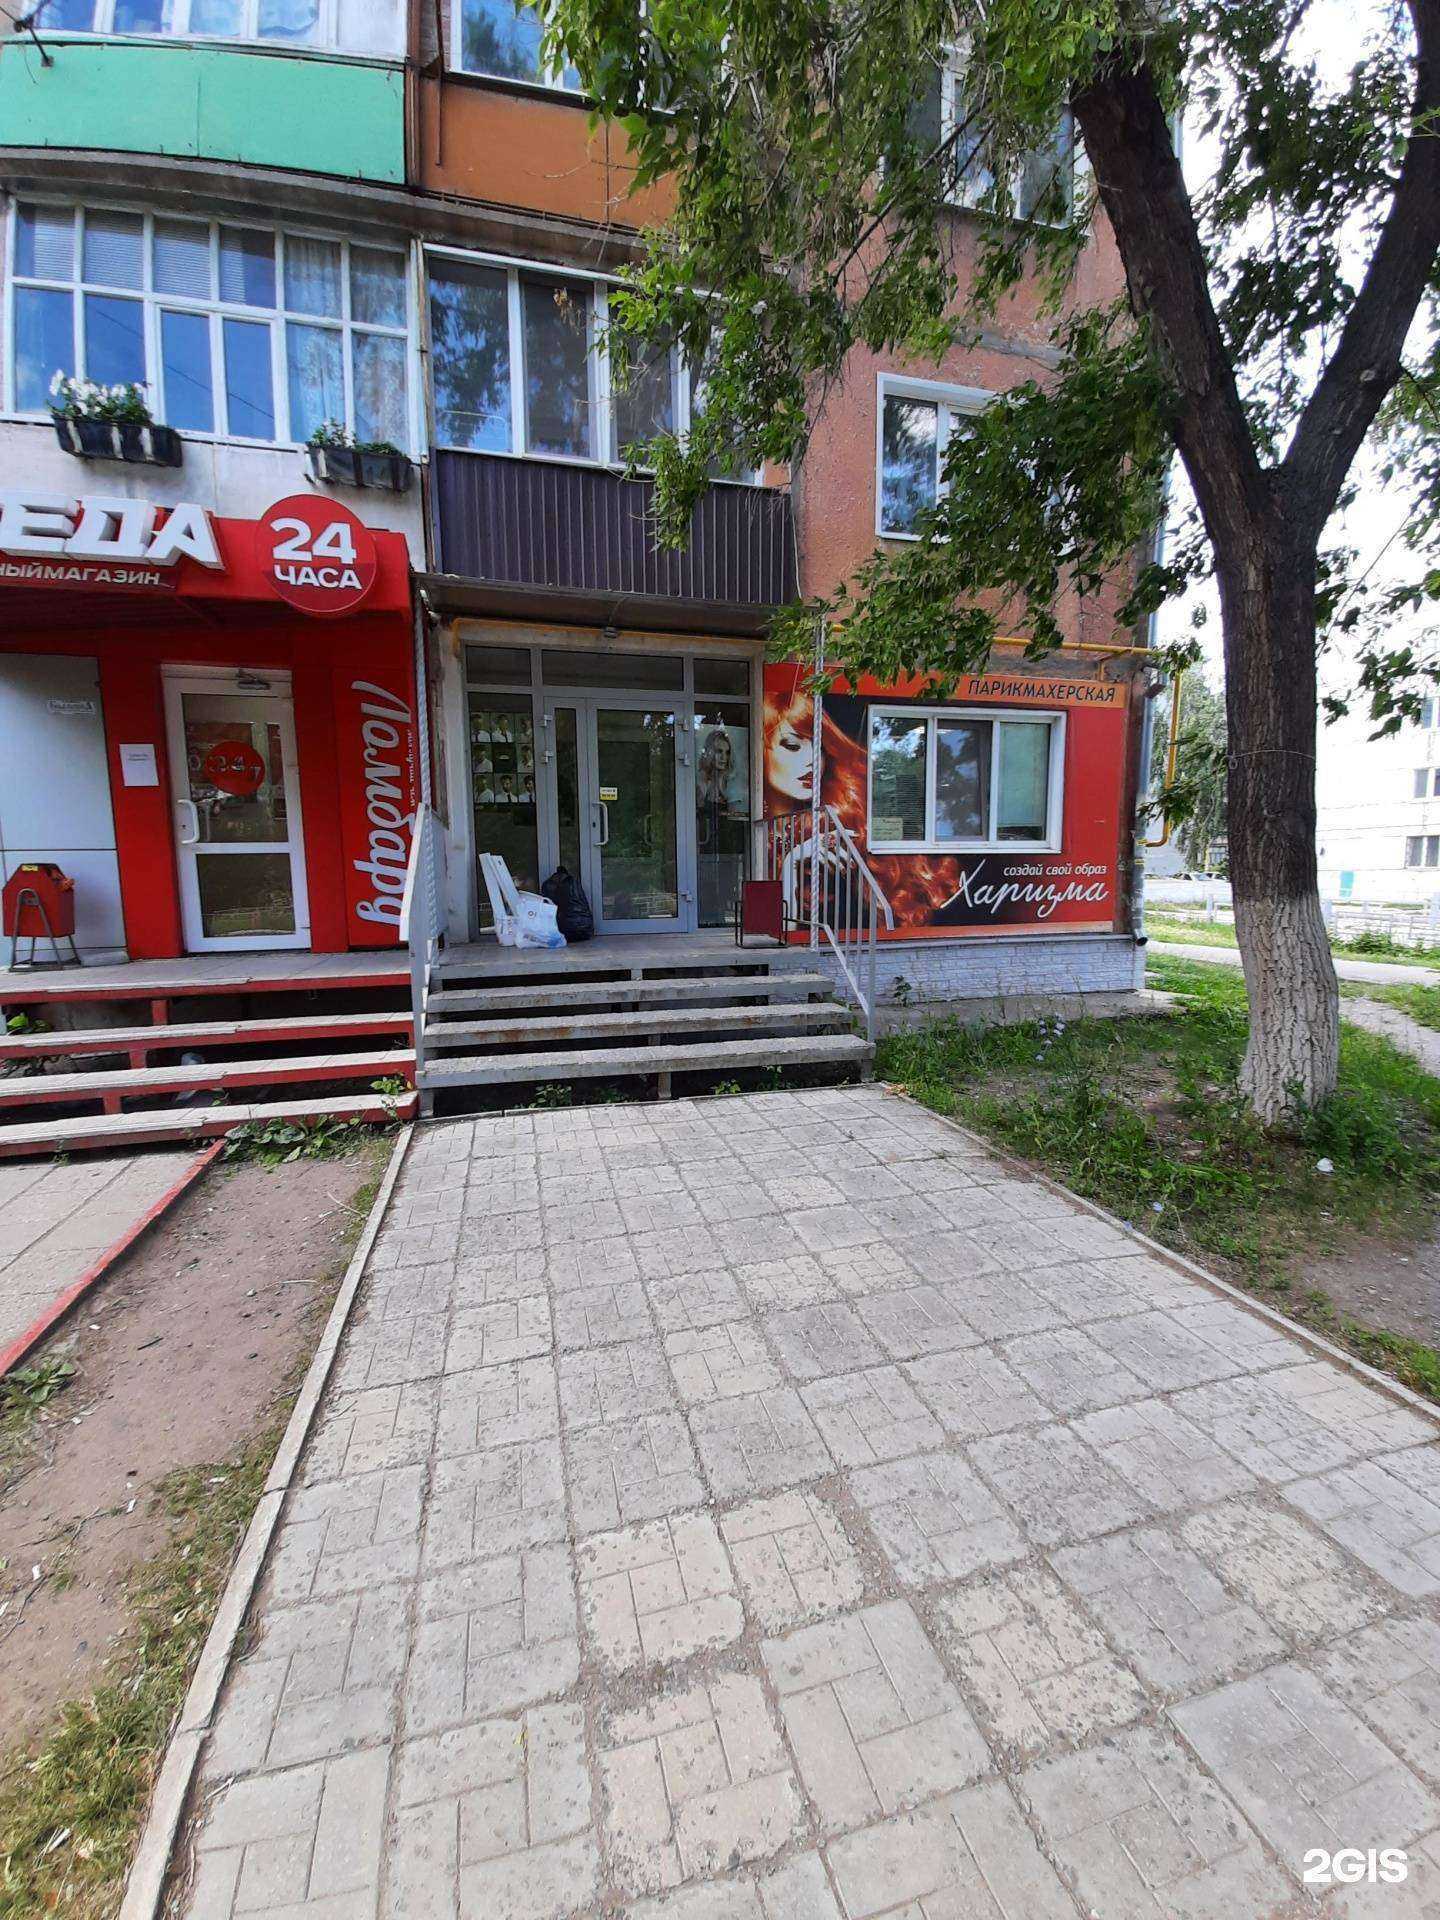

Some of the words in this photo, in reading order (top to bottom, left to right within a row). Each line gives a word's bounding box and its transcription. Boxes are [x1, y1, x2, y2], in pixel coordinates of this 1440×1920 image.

[0, 495, 223, 569] ЕДА
[270, 517, 357, 565] 24
[273, 564, 363, 590] ЧАСА
[968, 679, 1116, 702] ПАРИКМАХЕРСКАЯ
[351, 680, 416, 926] Ломбард
[940, 859, 1109, 918] Харизма
[1003, 863, 1043, 876] создай
[1045, 862, 1073, 876] свой
[1074, 863, 1107, 877] образ
